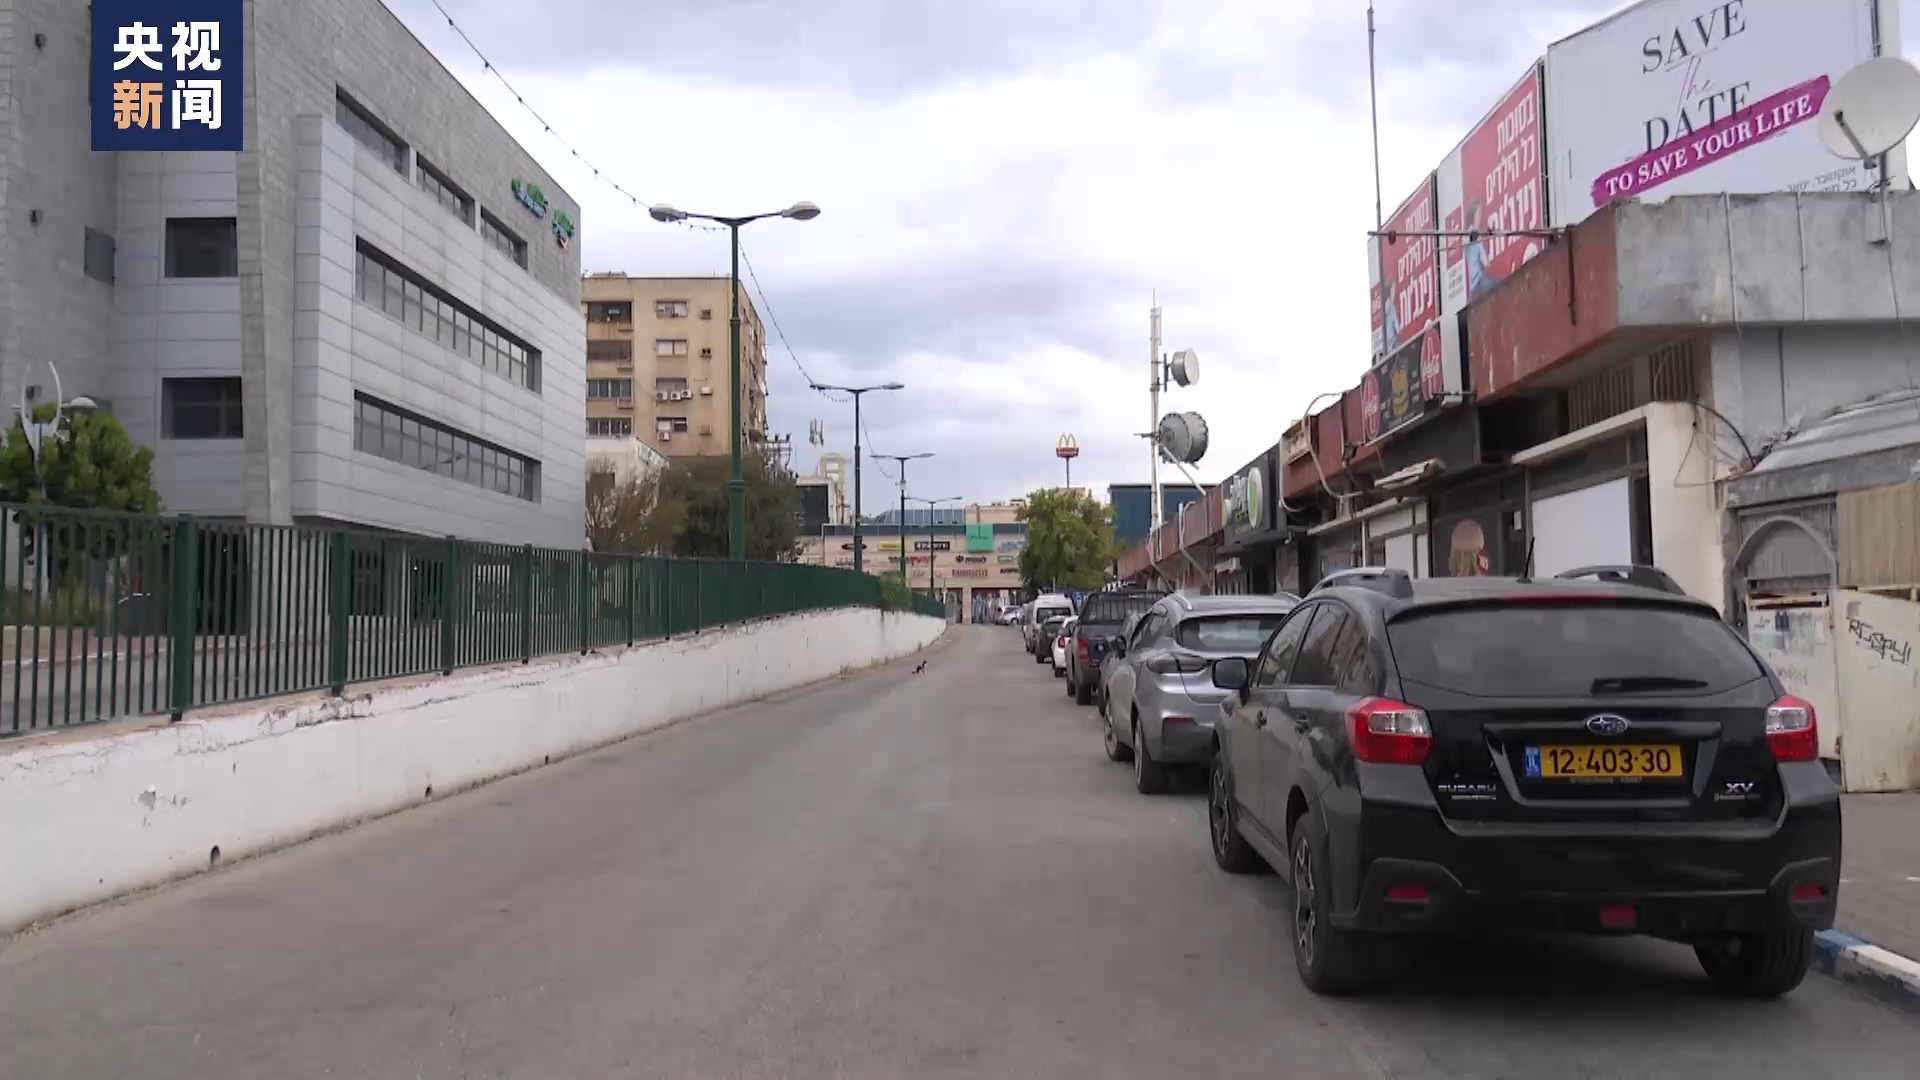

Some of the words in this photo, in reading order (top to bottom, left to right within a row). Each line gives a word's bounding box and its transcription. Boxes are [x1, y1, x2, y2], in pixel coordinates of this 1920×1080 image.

[1642, 0, 1746, 74] SAVE
[1605, 173, 1633, 197] TO
[1638, 149, 1688, 186] SAVE
[1690, 120, 1752, 162] YOUR
[1755, 94, 1813, 136] LIFE
[1641, 81, 1752, 153] DATE
[1725, 782, 1755, 794] XV
